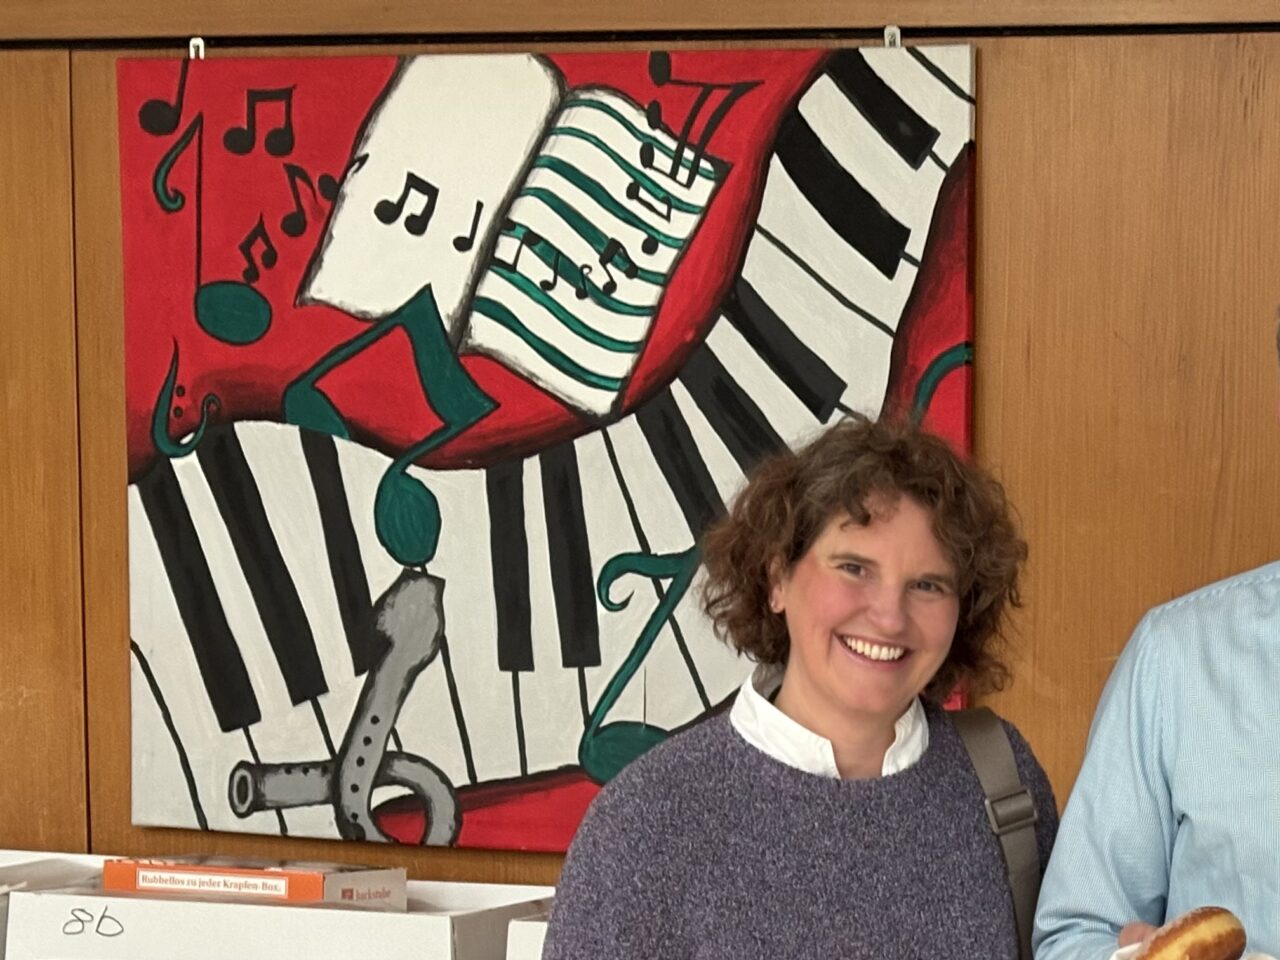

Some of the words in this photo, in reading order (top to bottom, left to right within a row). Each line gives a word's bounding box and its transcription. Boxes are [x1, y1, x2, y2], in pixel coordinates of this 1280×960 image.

[141, 874, 185, 886] Rubbellos
[198, 877, 221, 889] jeder
[62, 904, 124, 937] 8b
